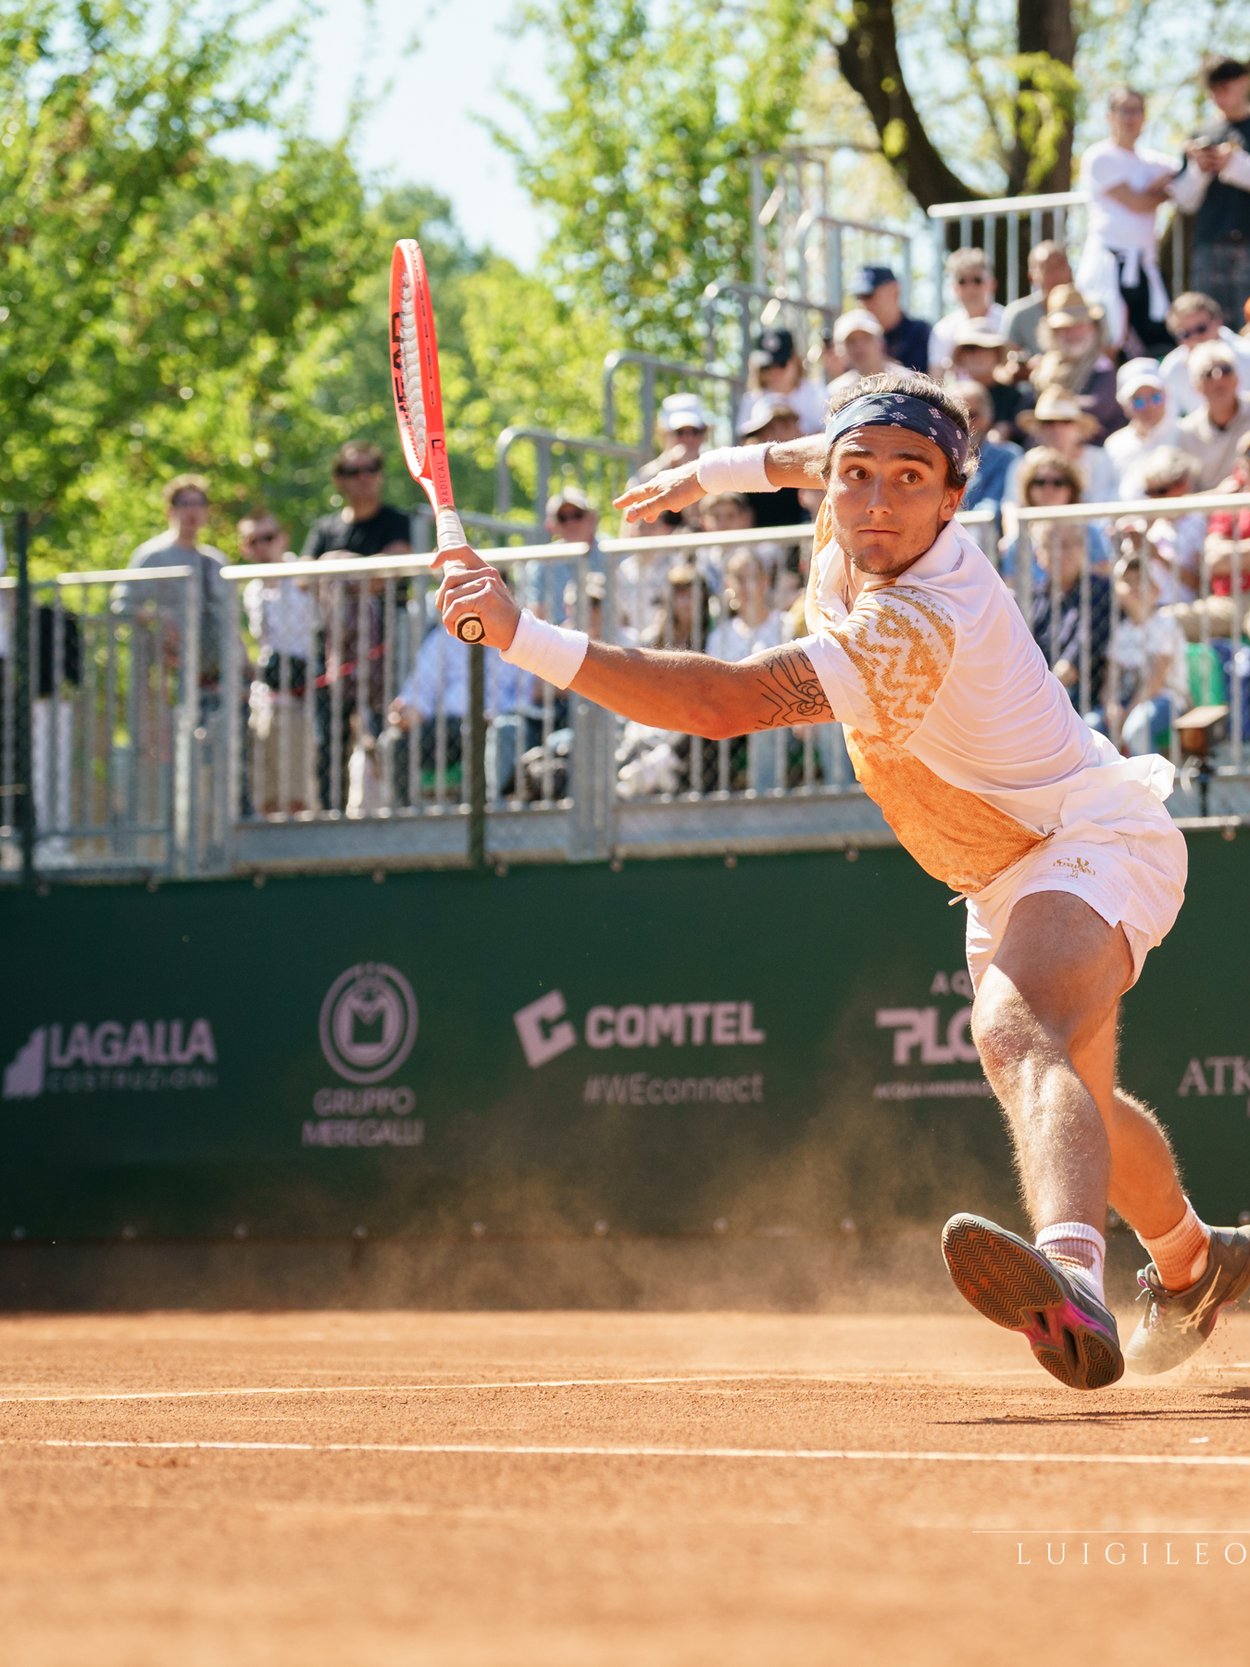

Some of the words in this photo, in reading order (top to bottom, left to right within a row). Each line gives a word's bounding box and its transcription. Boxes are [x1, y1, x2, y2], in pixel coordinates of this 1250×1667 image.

[437, 460, 451, 504] RADICAL
[48, 1018, 217, 1067] LAGALLA
[585, 1001, 765, 1049] COMTEL
[313, 1087, 416, 1116] GRUPPO
[581, 1072, 764, 1105] #WEconnect
[302, 1119, 425, 1147] MEREGALLI
